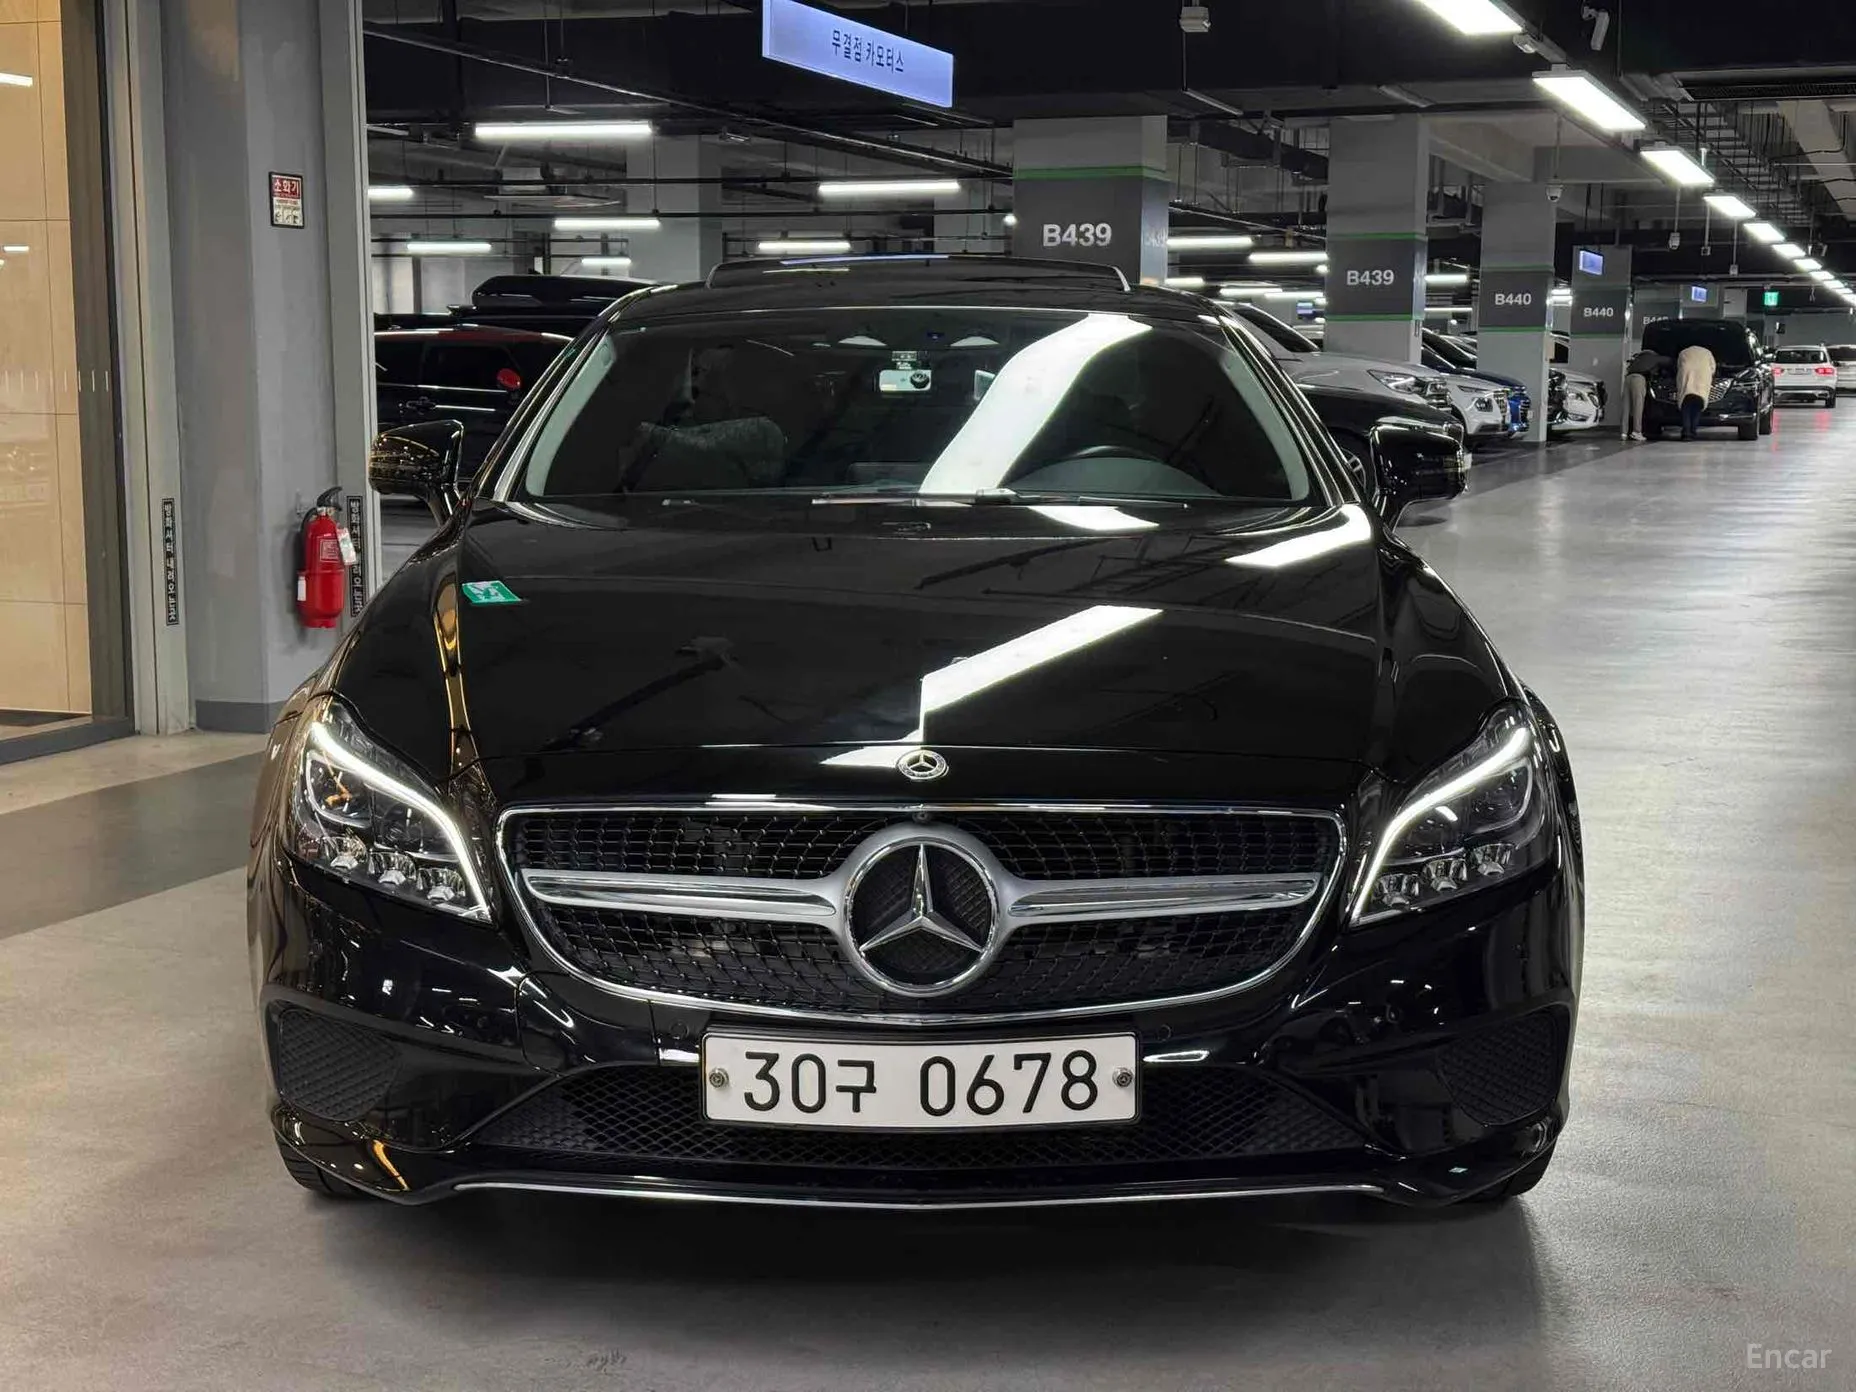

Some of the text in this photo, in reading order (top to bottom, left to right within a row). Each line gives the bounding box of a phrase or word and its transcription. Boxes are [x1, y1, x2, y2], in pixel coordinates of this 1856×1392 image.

[832, 29, 904, 74] 무결점 카모터스
[273, 178, 299, 197] 소화기
[1042, 222, 1112, 247] B439
[1346, 269, 1395, 286] B439
[1494, 293, 1532, 306] B440
[1583, 307, 1614, 318] B440
[743, 1049, 1099, 1117] 30구 0678
